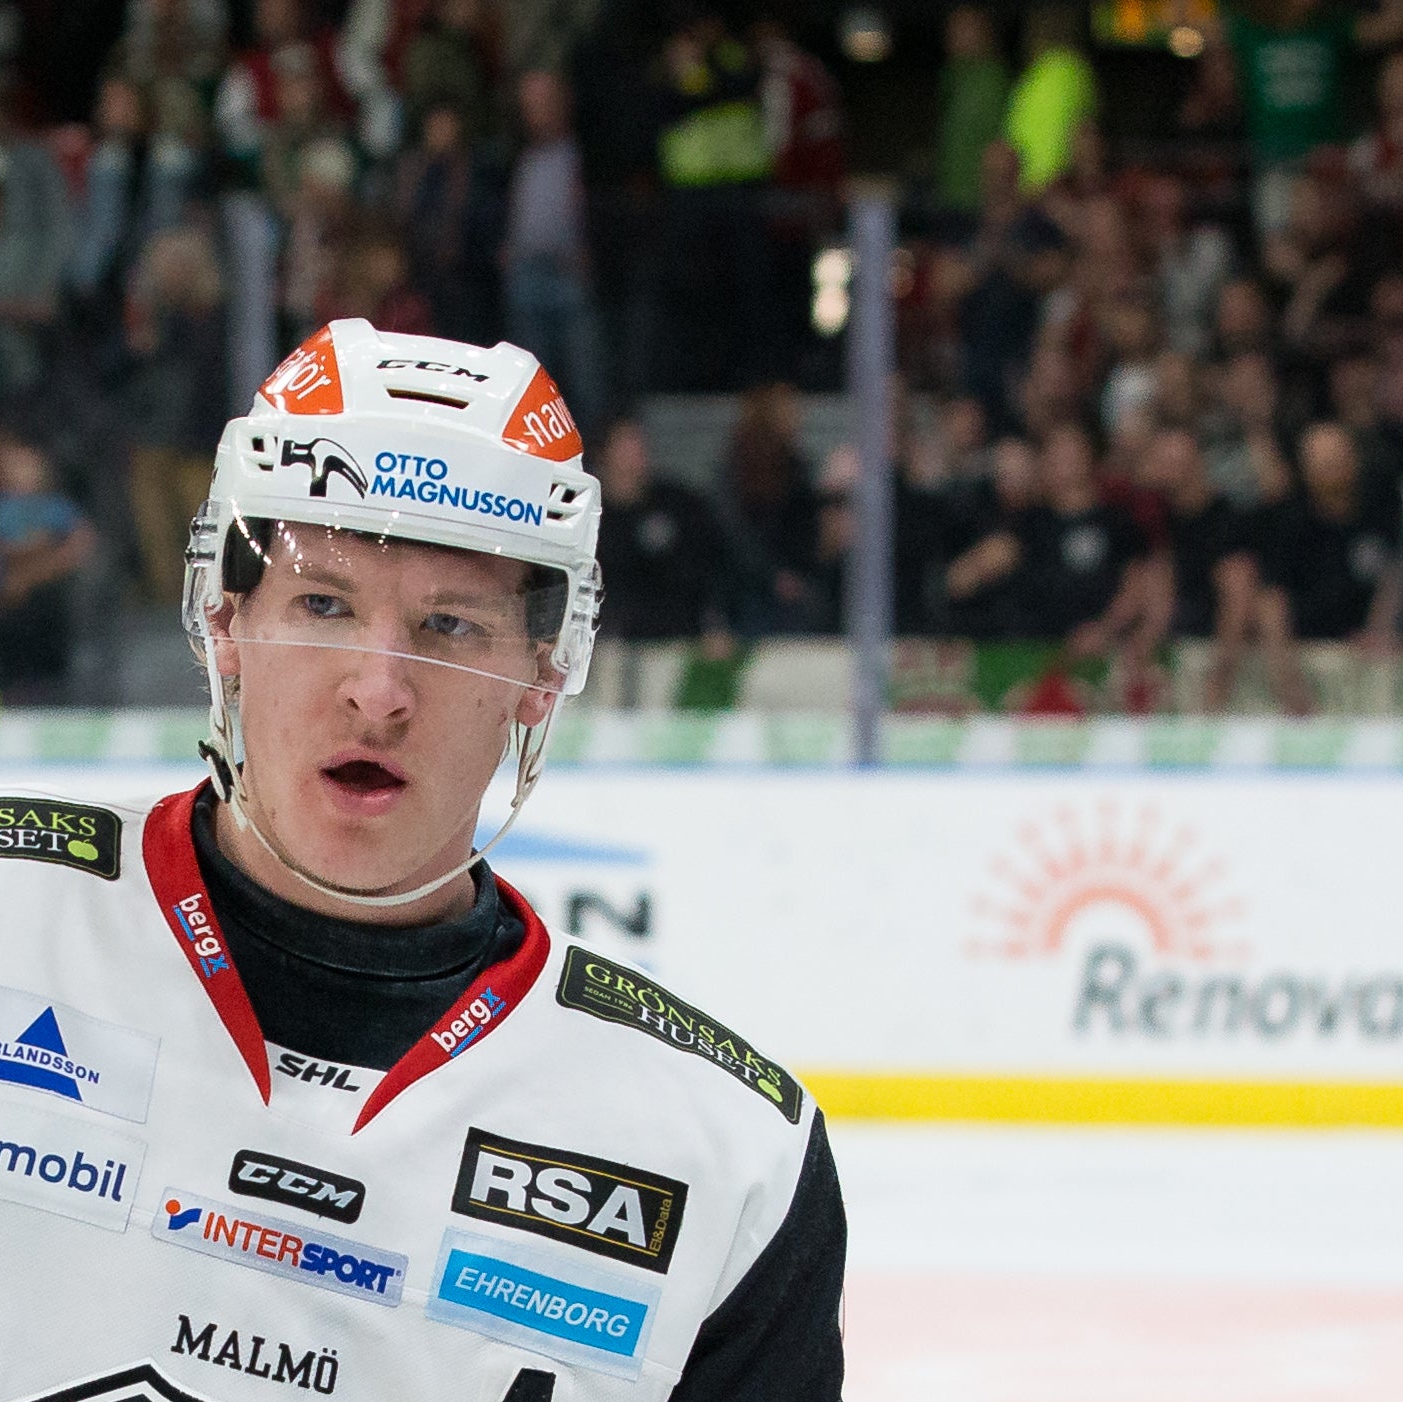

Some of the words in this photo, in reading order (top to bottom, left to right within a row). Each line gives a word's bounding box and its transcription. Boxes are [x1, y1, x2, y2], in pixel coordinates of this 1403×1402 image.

[376, 359, 490, 383] CCM
[370, 475, 543, 526] MAGNUSSON
[375, 452, 448, 480] OTTO
[585, 963, 782, 1086] GRÖNSAKS
[637, 1005, 760, 1083] HUSET
[275, 1053, 361, 1093] SHL
[236, 1160, 361, 1210] CCM
[469, 1150, 647, 1248] RSA
[203, 1211, 395, 1294] INTERSPORT
[454, 1266, 631, 1338] EHRENBORG
[170, 1314, 339, 1395] MALMÖ
